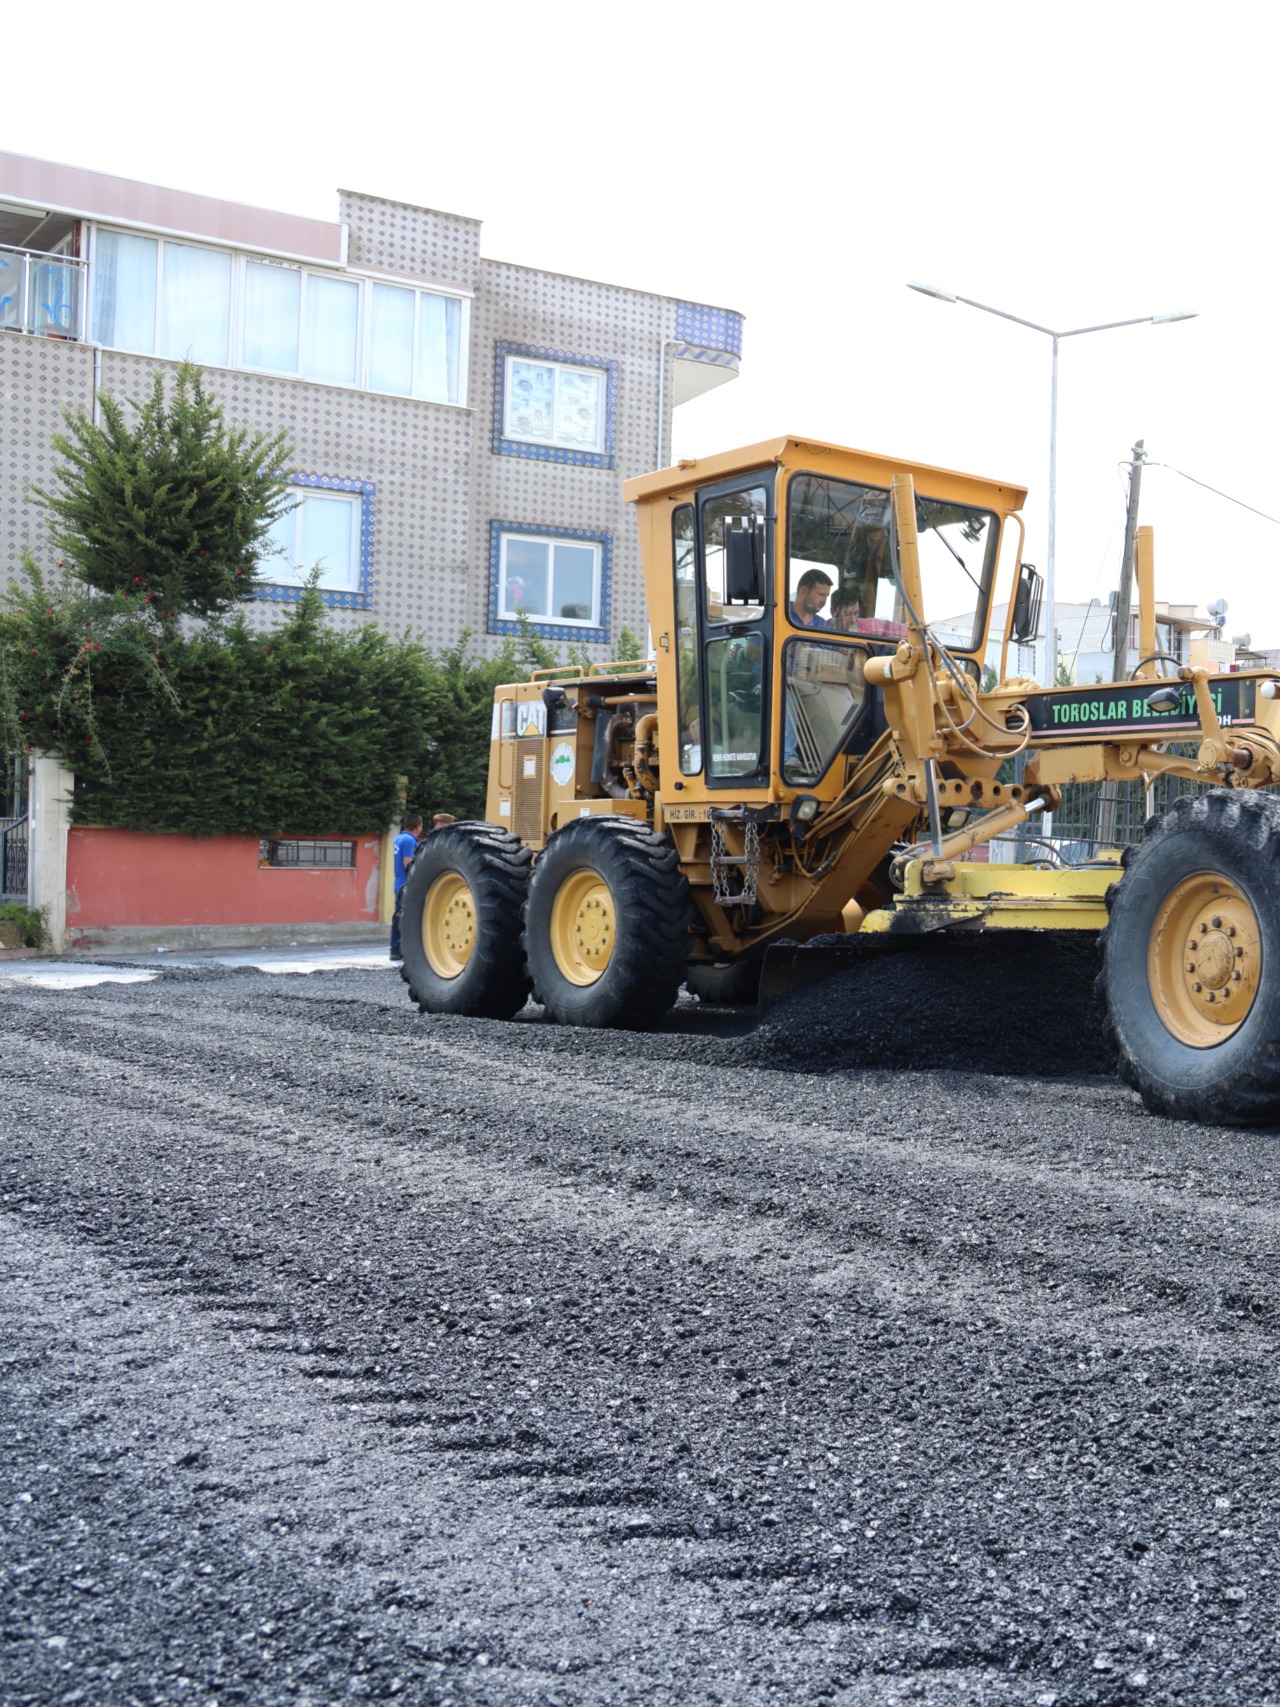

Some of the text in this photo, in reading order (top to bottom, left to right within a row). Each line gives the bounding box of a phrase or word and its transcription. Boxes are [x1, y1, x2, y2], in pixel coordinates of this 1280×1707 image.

[517, 703, 547, 736] CAT
[1052, 688, 1222, 723] TOROSLAR BEİYİ
